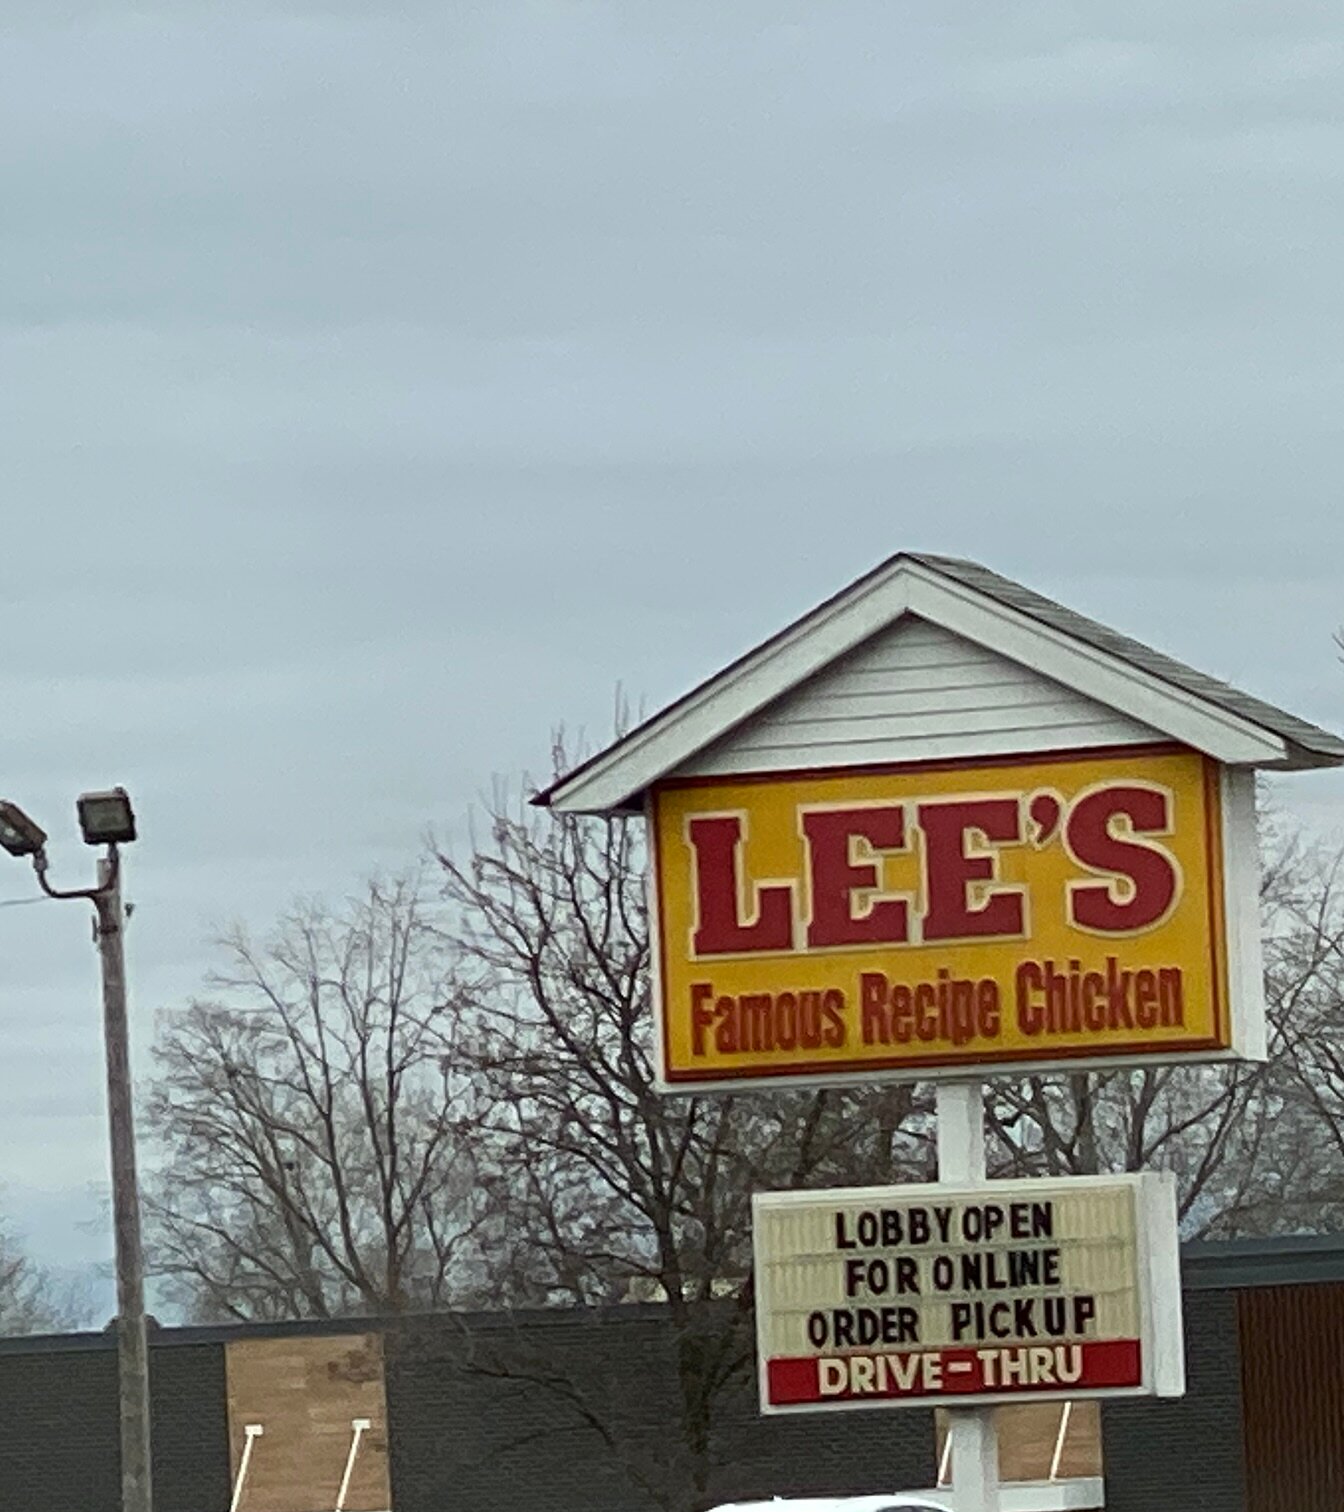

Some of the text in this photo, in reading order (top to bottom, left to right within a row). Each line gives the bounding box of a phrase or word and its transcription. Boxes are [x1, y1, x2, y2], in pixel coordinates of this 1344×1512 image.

[685, 780, 1183, 961] LEE'S
[689, 956, 1184, 1056] Famous Recipe Chicken
[834, 1201, 1054, 1251] LOBBY OPEN
[844, 1248, 1062, 1297] FOR ONLINE
[806, 1306, 920, 1348] ORDER
[817, 1344, 1084, 1396] DRIVE-THRU
